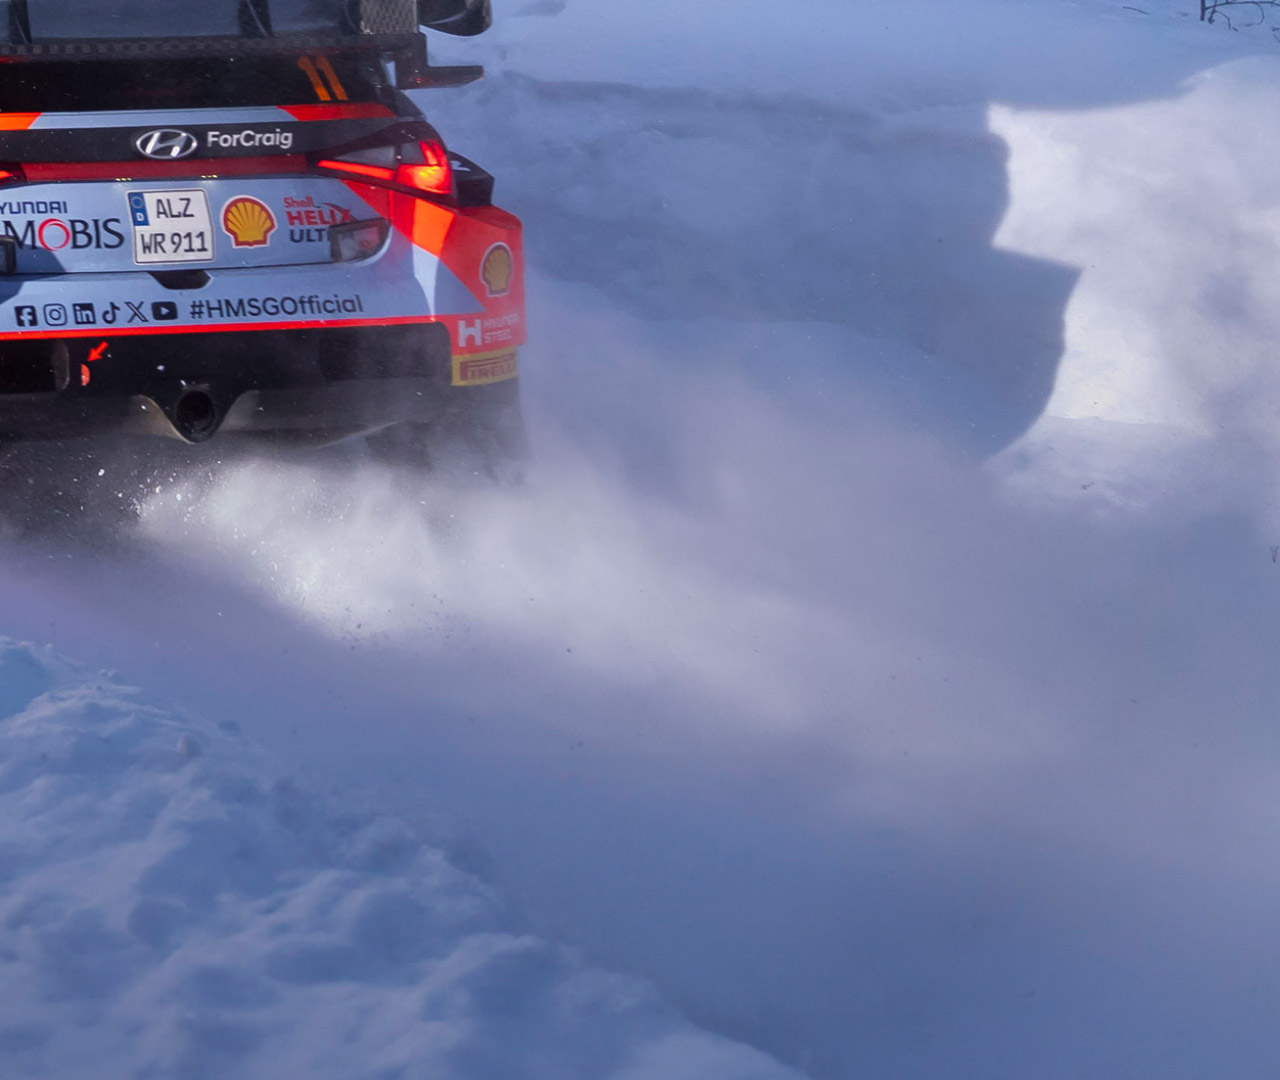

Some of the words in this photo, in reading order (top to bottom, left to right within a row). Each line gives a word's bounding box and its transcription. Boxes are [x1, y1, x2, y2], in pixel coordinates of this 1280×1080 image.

[297, 56, 349, 101] 11
[207, 131, 294, 149] ForCraig
[156, 197, 195, 219] ALZ
[283, 196, 314, 208] Shell
[286, 209, 355, 226] HELIX
[4, 218, 125, 252] MOBIS
[140, 233, 167, 255] WR
[170, 231, 208, 254] 911
[289, 228, 330, 243] ULT
[189, 294, 364, 319] #HMSGOfficial
